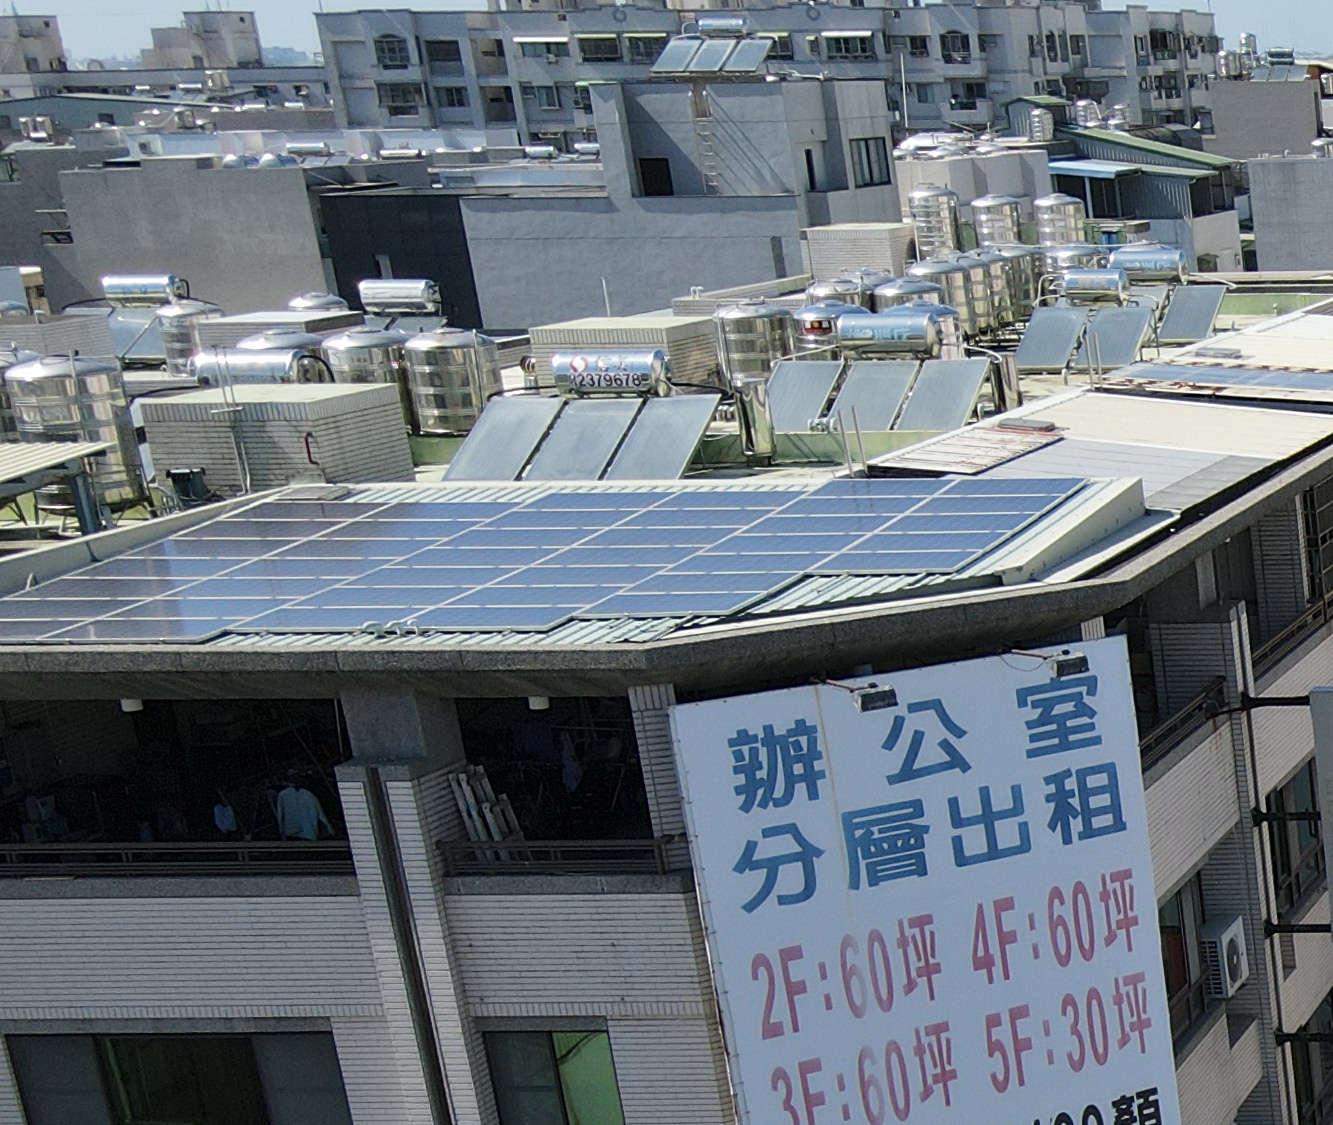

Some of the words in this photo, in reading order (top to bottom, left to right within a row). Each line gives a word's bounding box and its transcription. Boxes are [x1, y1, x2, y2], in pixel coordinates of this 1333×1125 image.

[727, 673, 1103, 814] 辦公室
[730, 761, 1128, 914] 分層出租
[749, 912, 943, 1041] 2F:60坪
[970, 867, 1140, 989] 4F:60坪
[985, 971, 1153, 1094] 5F:30坪
